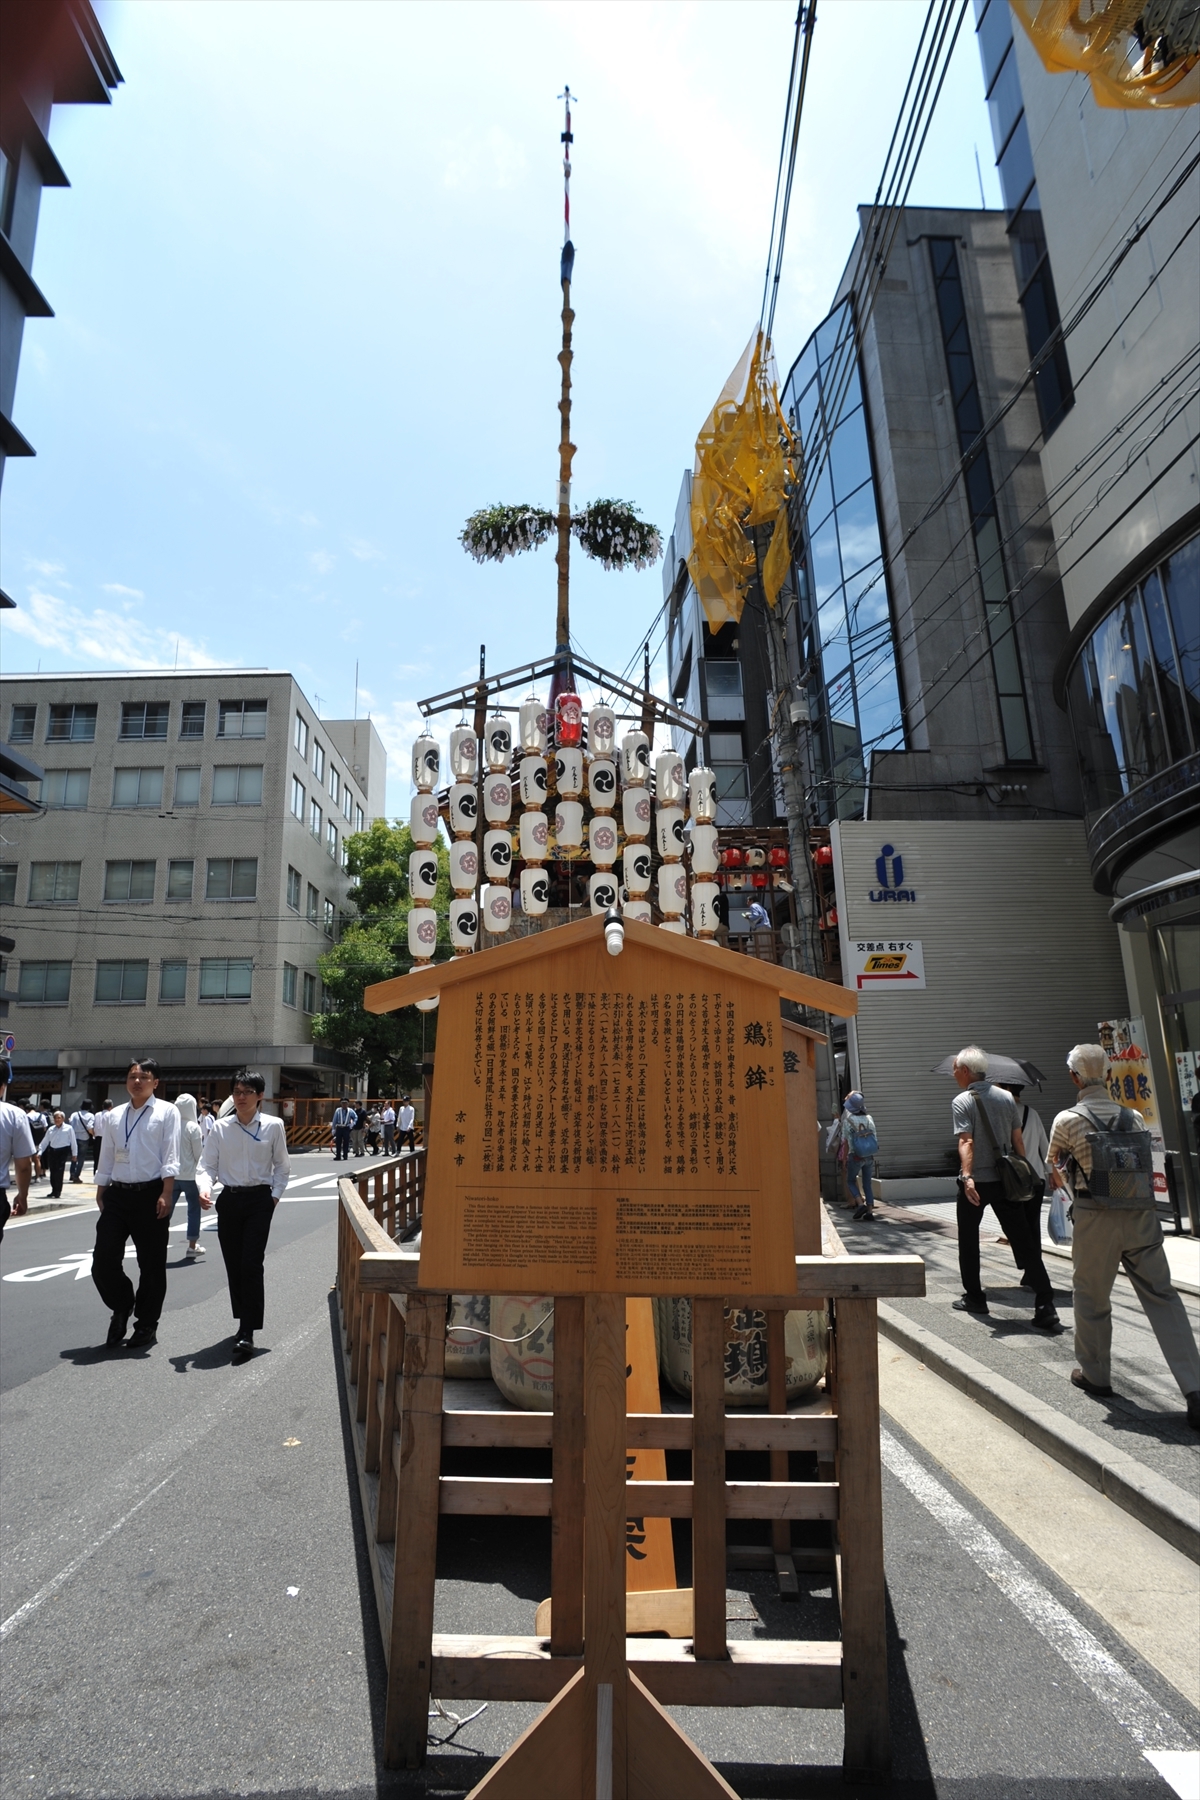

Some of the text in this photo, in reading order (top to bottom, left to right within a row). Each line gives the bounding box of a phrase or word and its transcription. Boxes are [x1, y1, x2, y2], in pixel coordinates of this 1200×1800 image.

[869, 891, 916, 902] URAI
[856, 942, 914, 952] 交差点 右すぐ
[871, 957, 900, 970] Times
[783, 1050, 801, 1073] 登
[453, 1110, 467, 1167] 京都市
[785, 1372, 813, 1386] Kyoto
